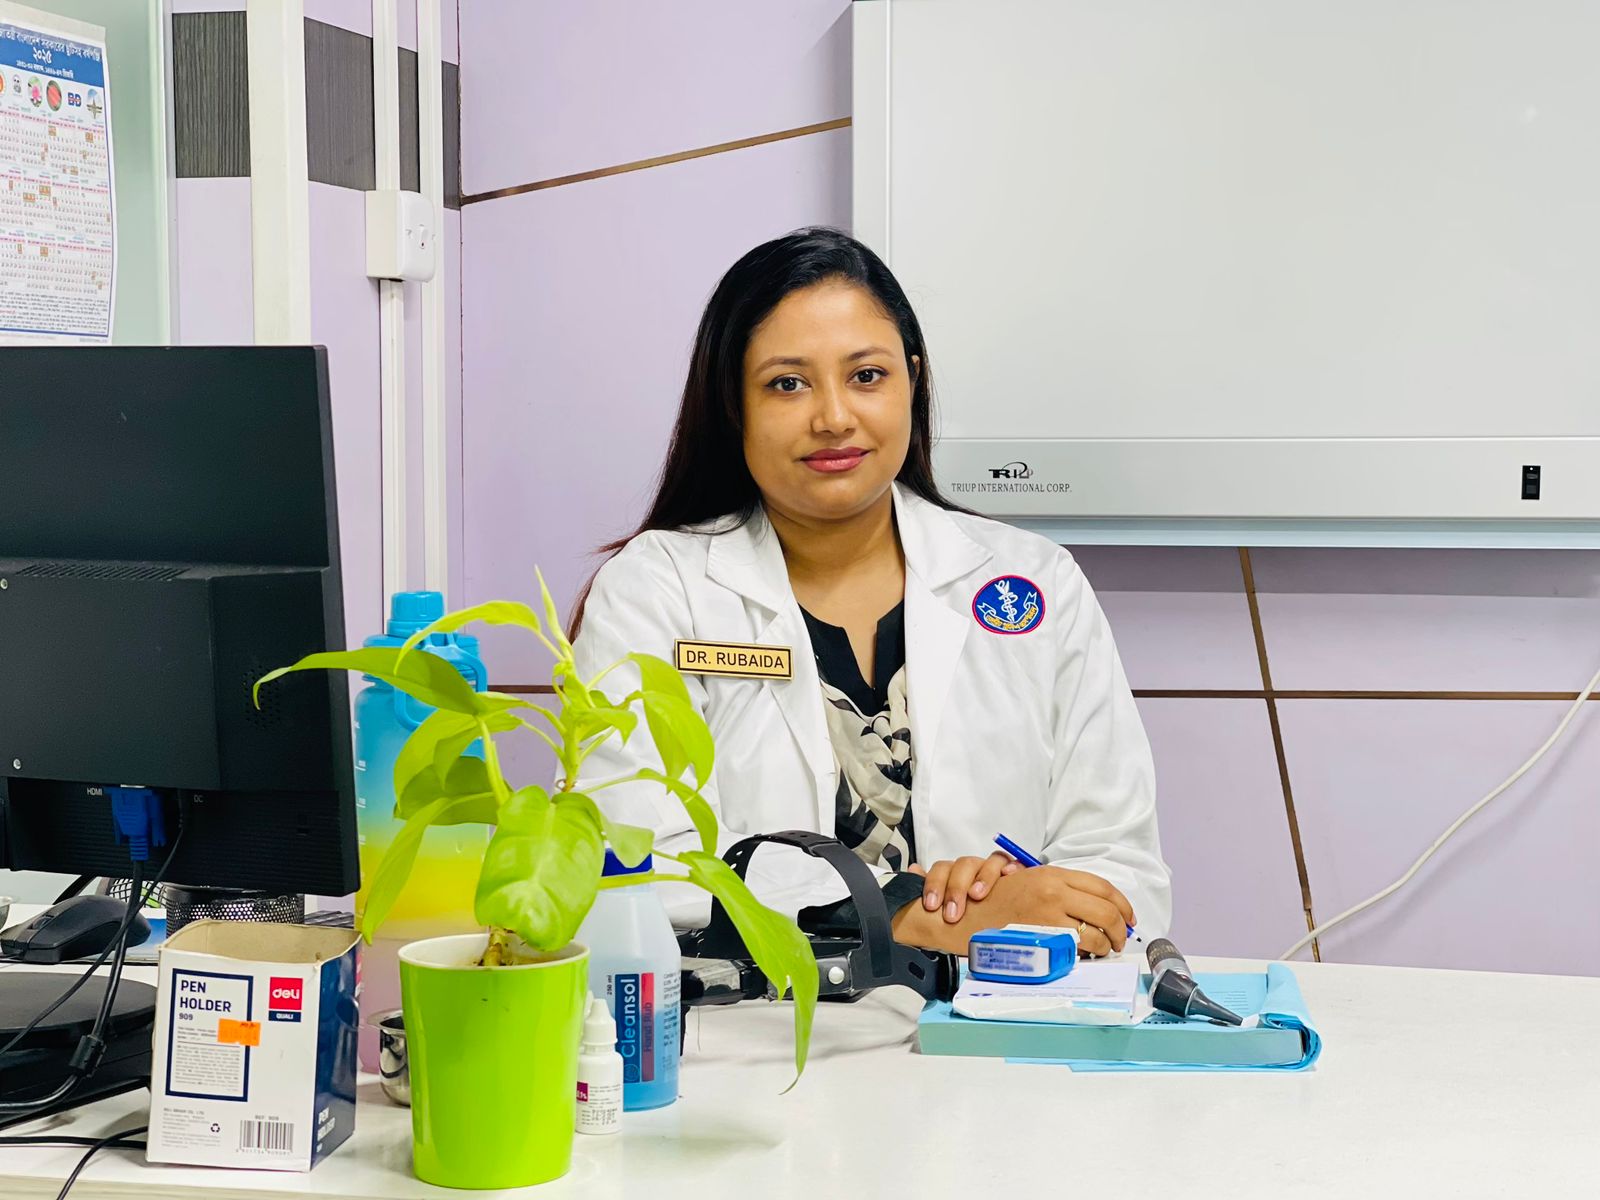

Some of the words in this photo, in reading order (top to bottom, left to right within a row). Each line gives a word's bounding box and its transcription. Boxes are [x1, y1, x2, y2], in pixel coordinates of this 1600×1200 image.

[32, 46, 52, 64] ২০২৫
[951, 483, 976, 493] TRIUP
[977, 483, 1045, 493] INTERNATIONAL
[1046, 483, 1073, 493] CORP.
[686, 650, 711, 664] DR.
[716, 652, 784, 669] RUBAIDA
[86, 787, 103, 796] HDMI
[180, 979, 206, 993] PEN
[272, 988, 300, 1000] deli
[179, 997, 232, 1013] HOLDER
[643, 1002, 653, 1023] Rub
[178, 1012, 194, 1021] 909
[620, 978, 636, 1057] Cleansol
